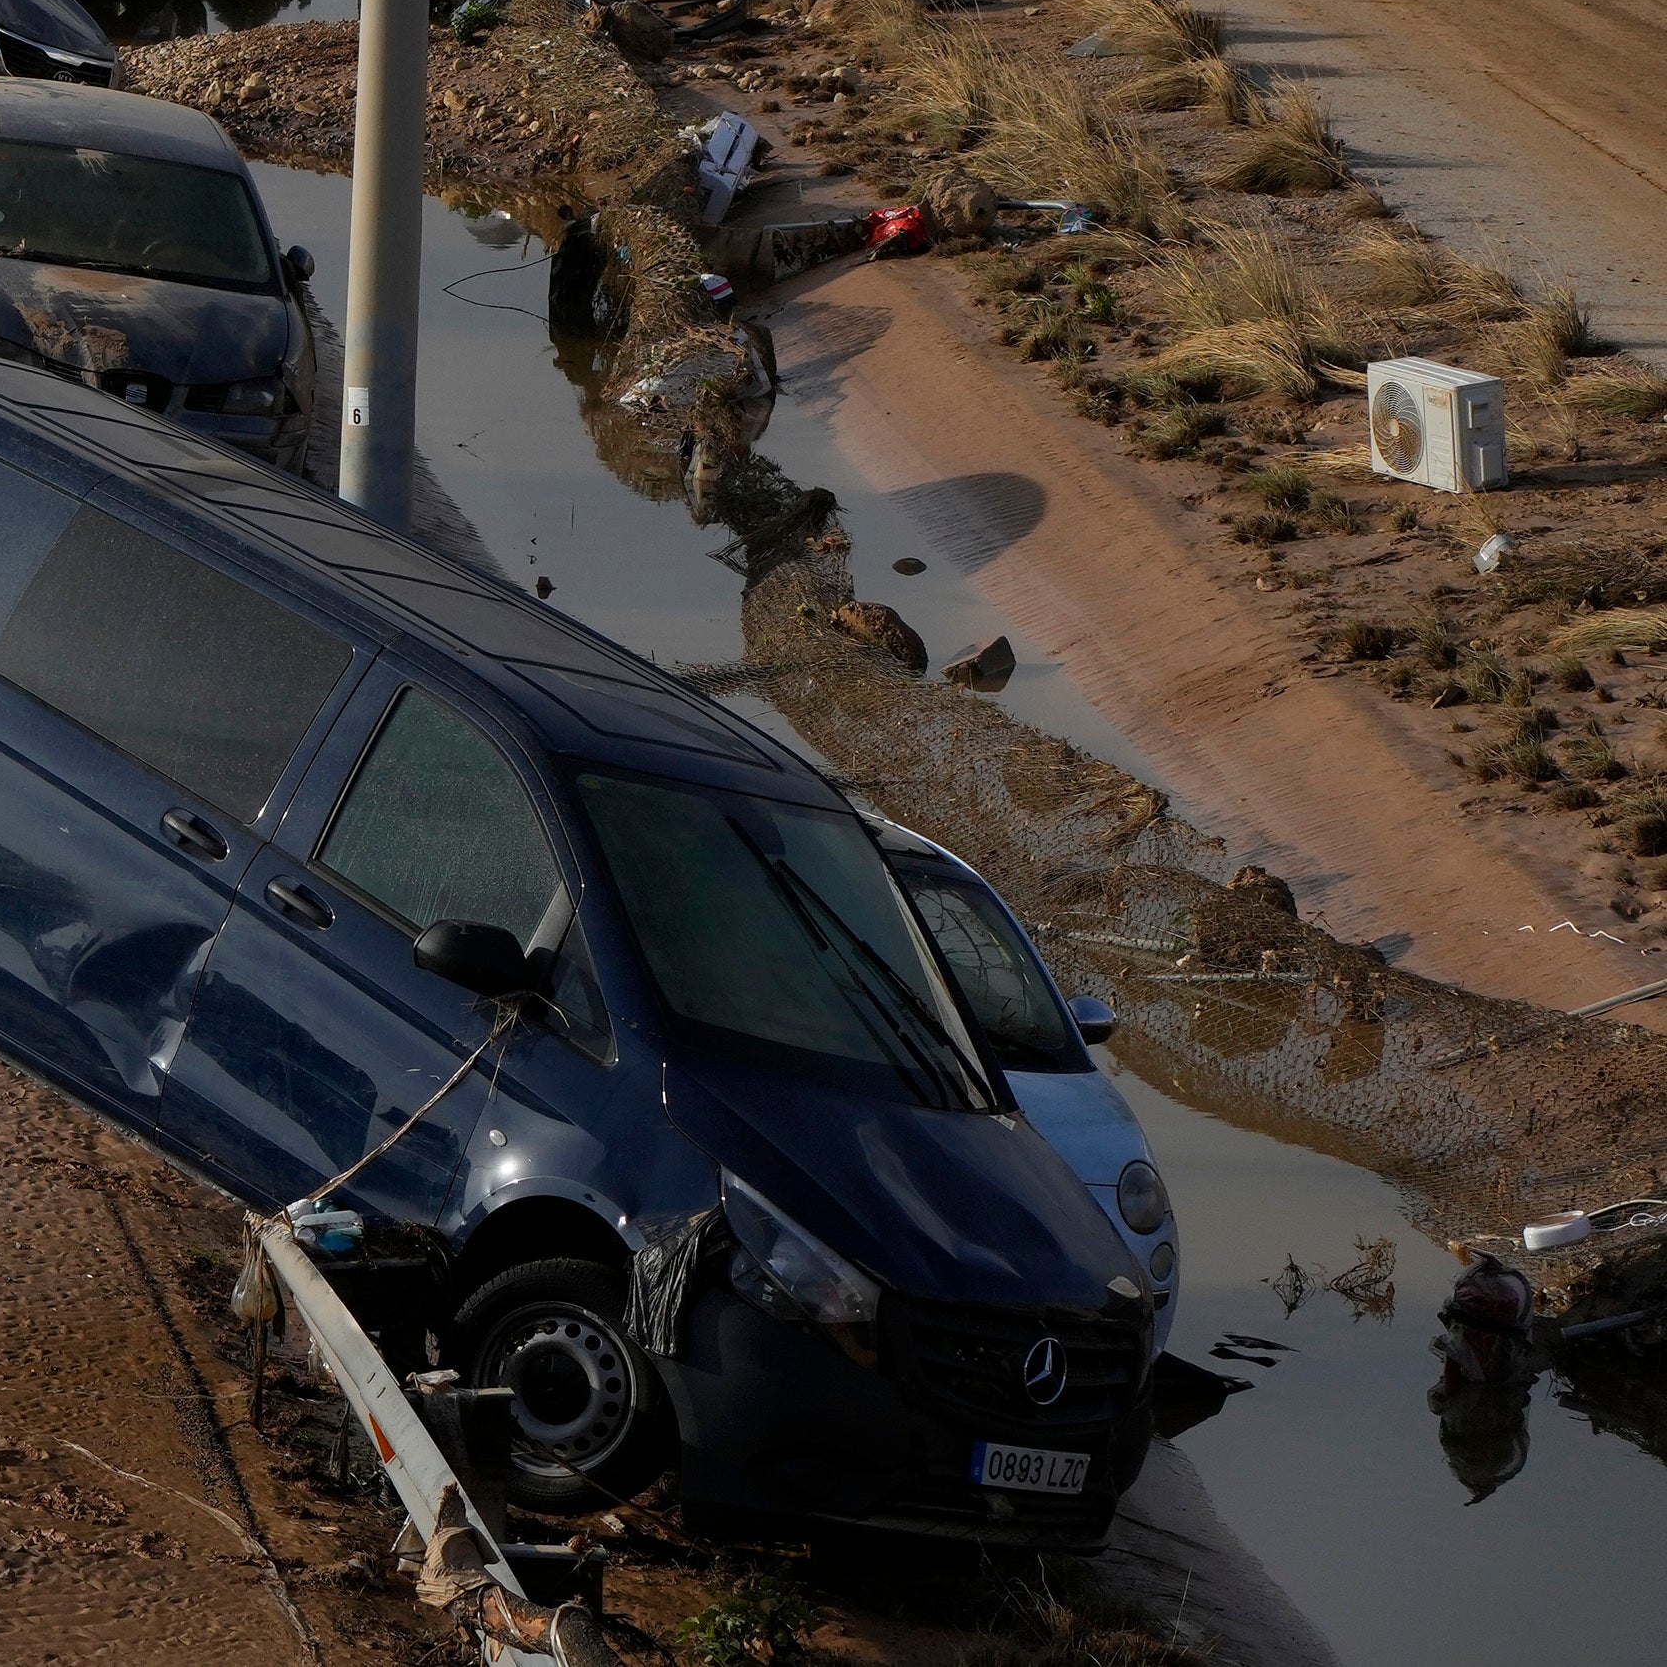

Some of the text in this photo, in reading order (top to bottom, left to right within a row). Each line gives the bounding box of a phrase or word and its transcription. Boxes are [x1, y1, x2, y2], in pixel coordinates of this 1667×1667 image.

[353, 408, 361, 424] 6
[988, 1450, 1044, 1485] 0893
[1046, 1456, 1085, 1488] LZC
